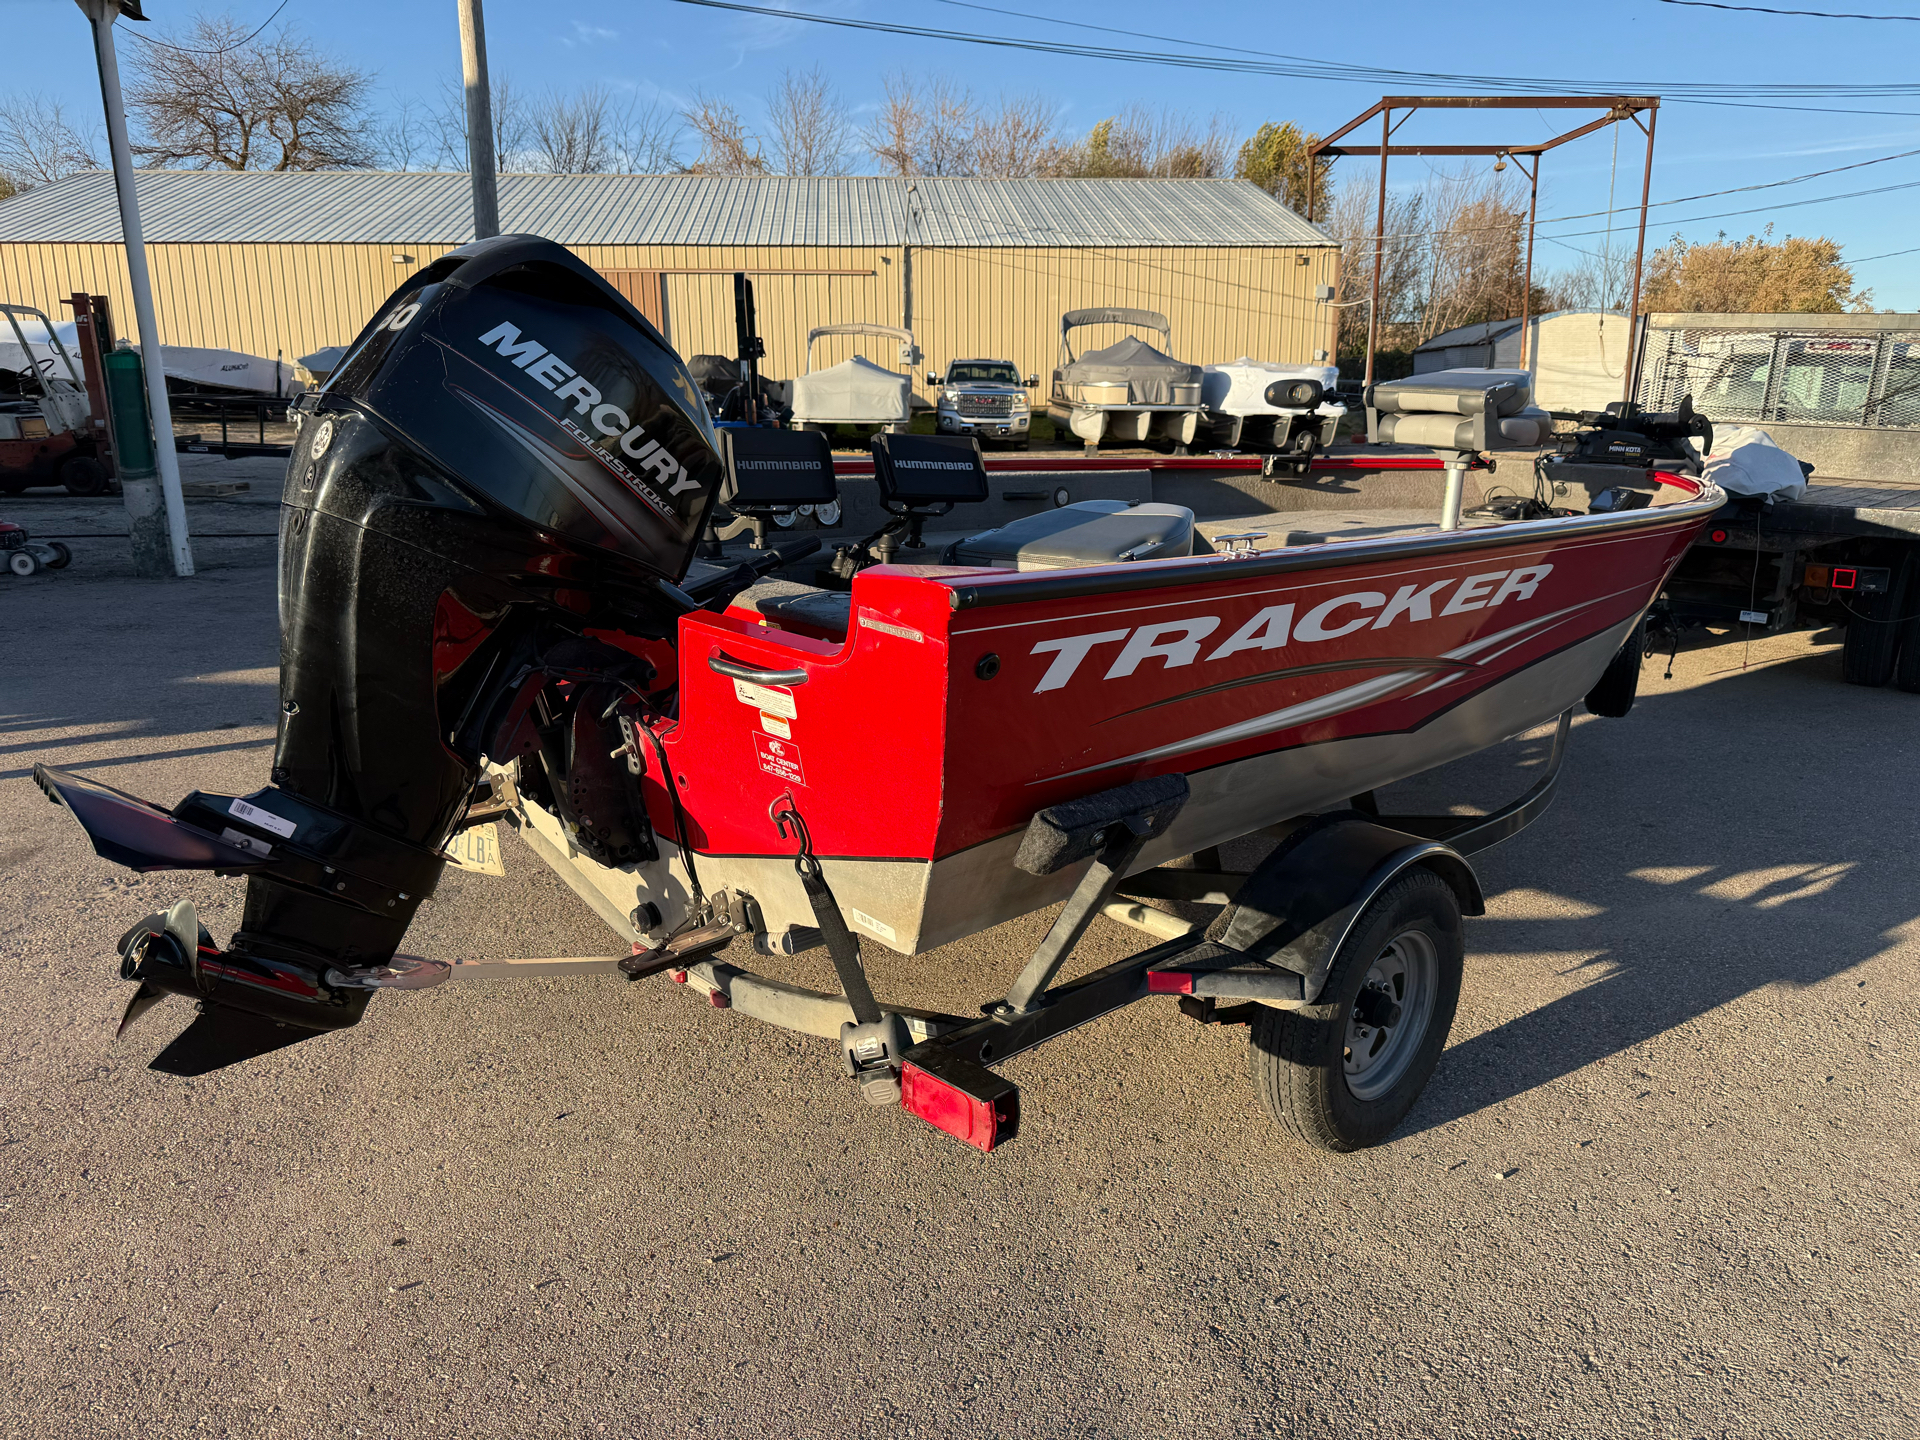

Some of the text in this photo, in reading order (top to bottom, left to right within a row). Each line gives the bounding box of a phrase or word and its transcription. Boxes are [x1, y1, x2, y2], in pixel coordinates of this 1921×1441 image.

[478, 321, 701, 496] MERCURY
[1609, 445, 1625, 453] MINN
[559, 418, 676, 517] FOURSTROKE
[737, 460, 822, 471] HUMMINBIRD
[894, 459, 974, 471] HUMMINBIRD
[1029, 564, 1554, 694] TRACKER
[760, 751, 775, 762] BOAT
[776, 757, 799, 771] CENTER
[467, 832, 485, 864] LB
